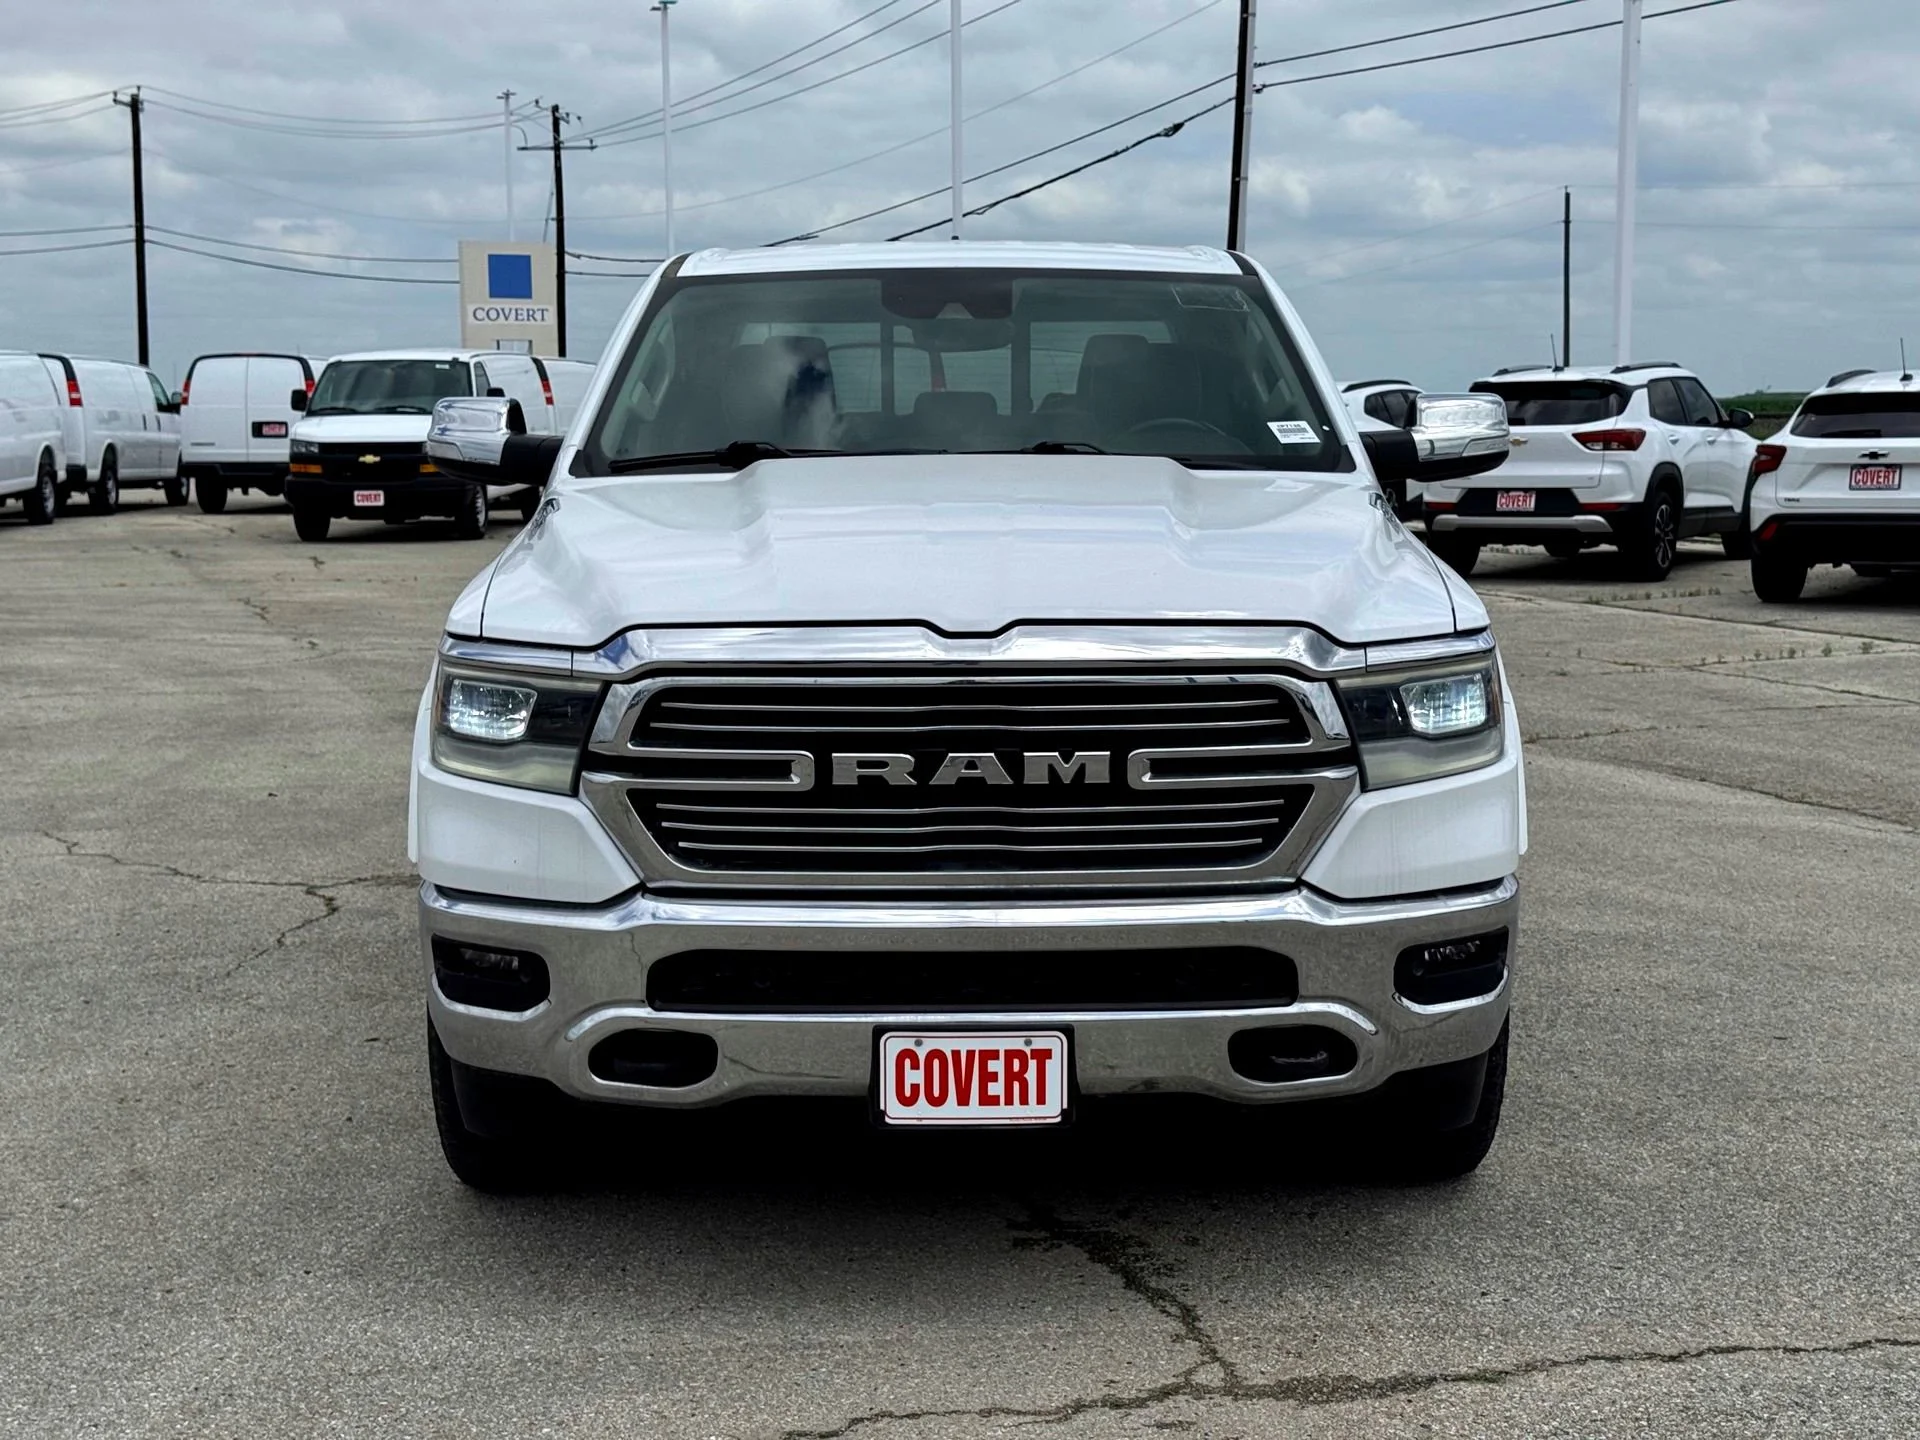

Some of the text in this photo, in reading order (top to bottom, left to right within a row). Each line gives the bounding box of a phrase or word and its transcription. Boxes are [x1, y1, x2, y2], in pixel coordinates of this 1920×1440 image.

[473, 307, 549, 321] COVERT
[1854, 469, 1898, 485] COVERT
[1500, 494, 1532, 508] COVERT
[832, 752, 1110, 785] RAM
[895, 1048, 1053, 1108] COVERT
